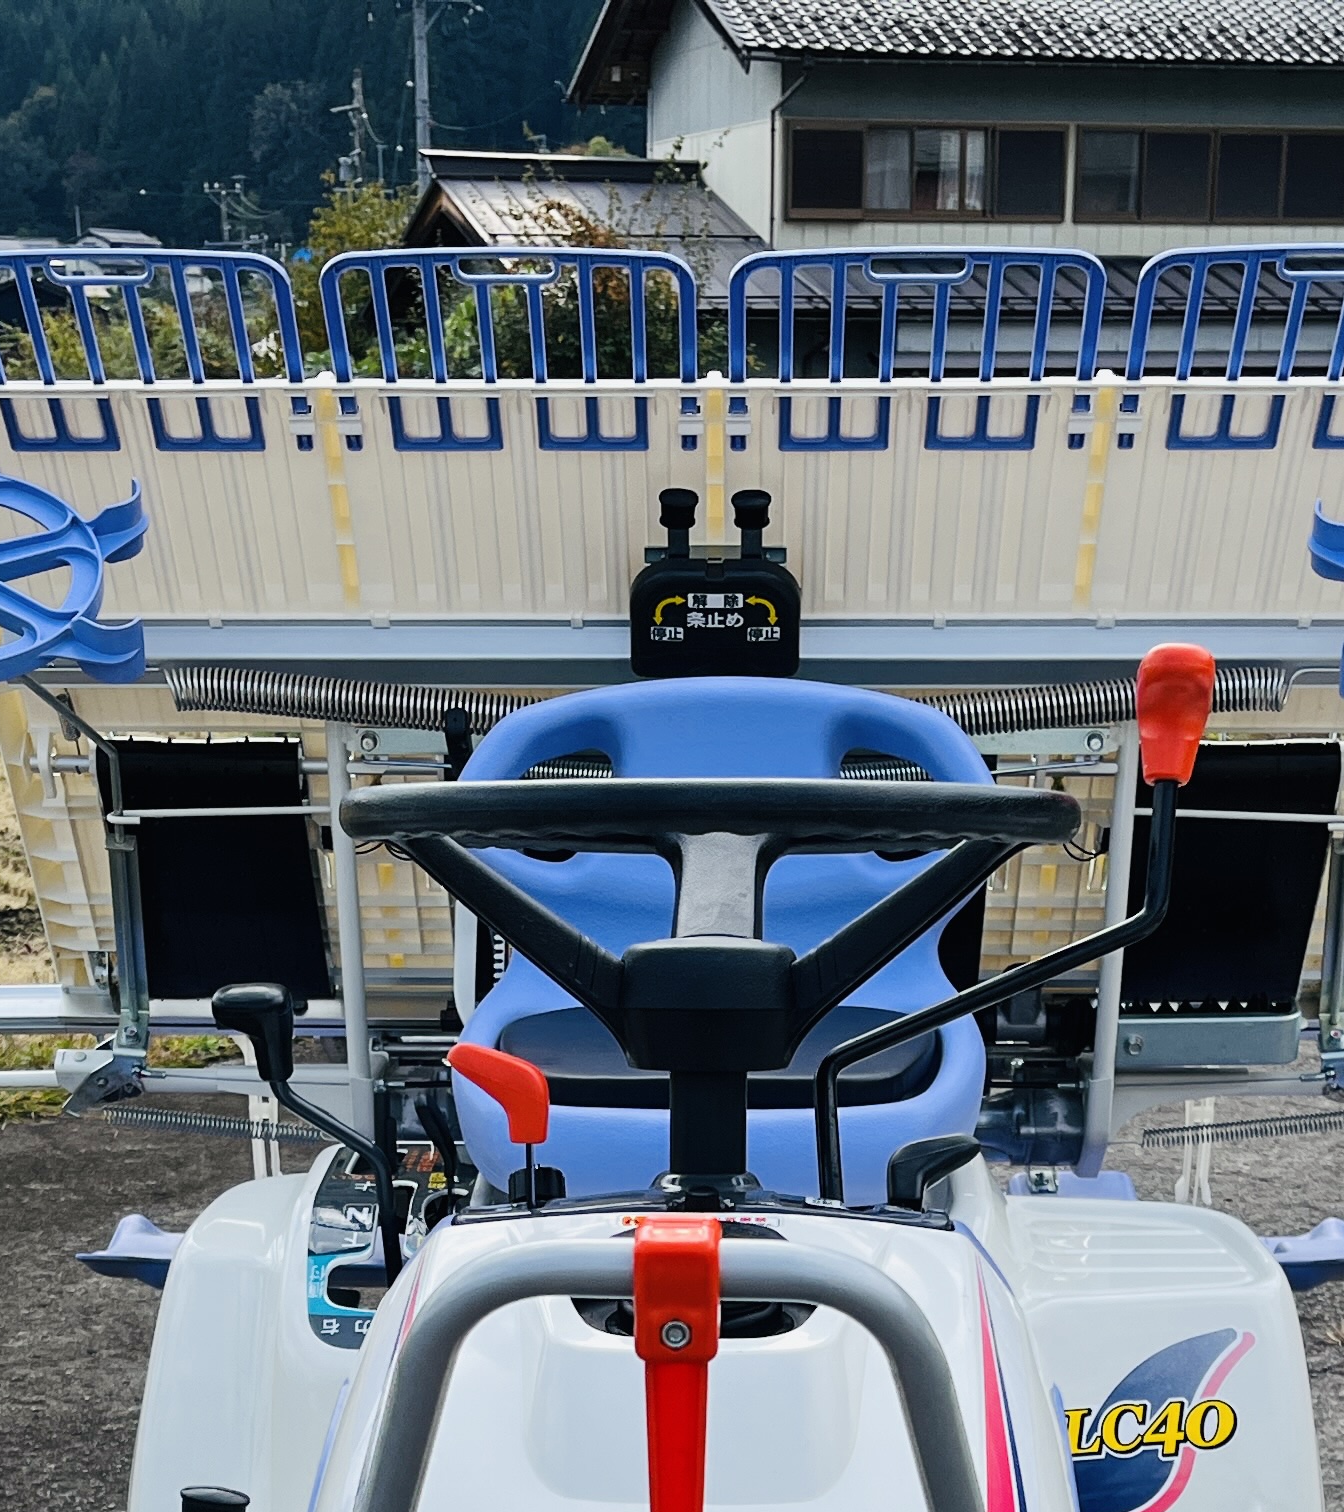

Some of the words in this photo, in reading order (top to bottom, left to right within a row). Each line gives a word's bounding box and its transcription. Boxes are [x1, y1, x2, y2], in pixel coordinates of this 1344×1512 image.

[686, 611, 744, 628] 条止め
[651, 627, 683, 641] 停止
[748, 627, 779, 641] 停止
[1064, 1398, 1238, 1457] LC40
